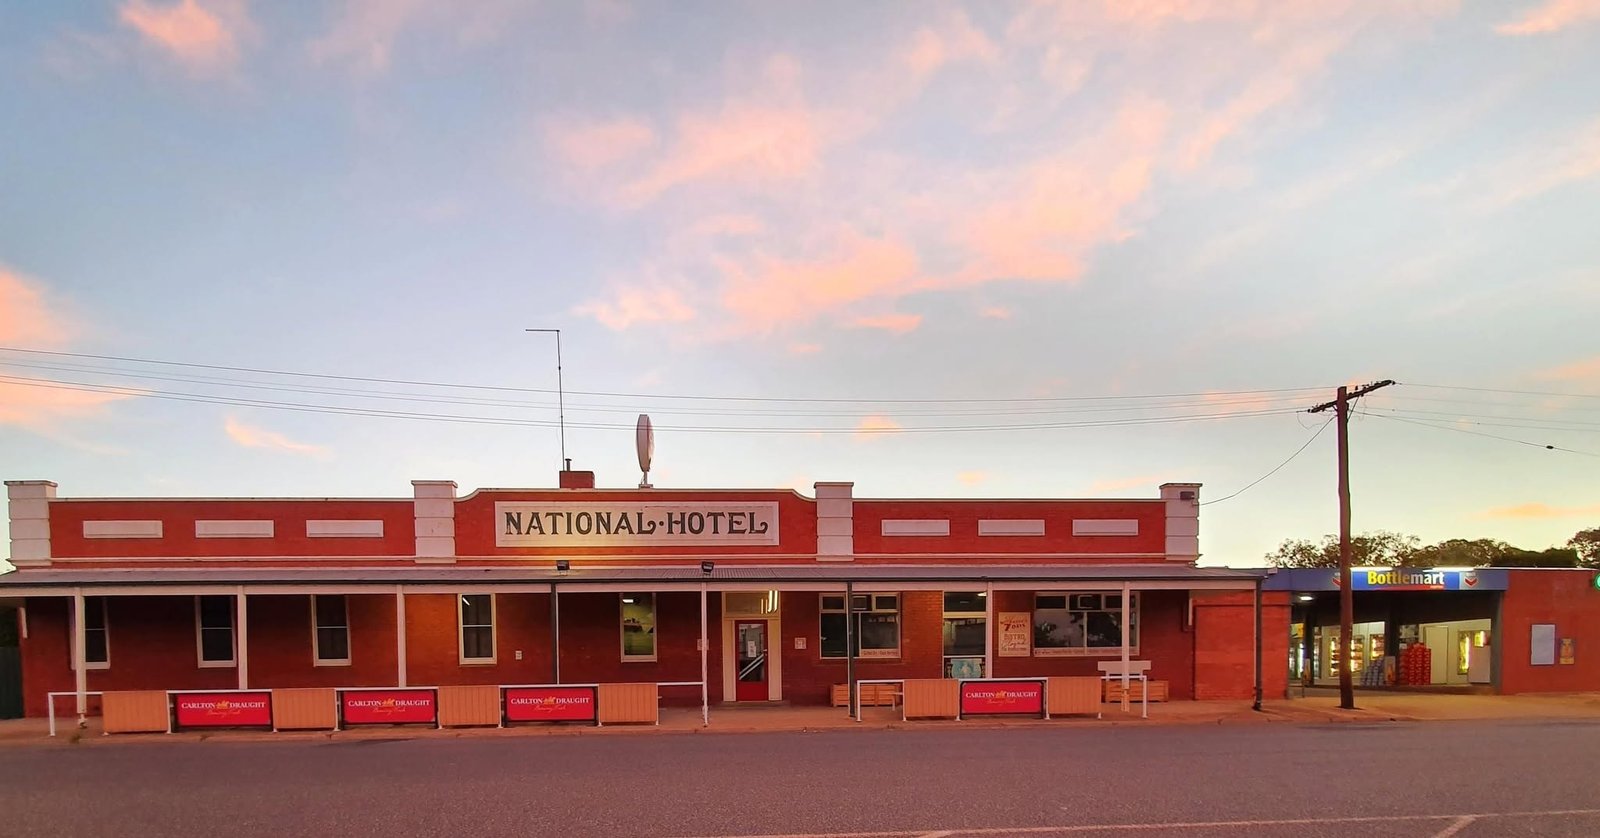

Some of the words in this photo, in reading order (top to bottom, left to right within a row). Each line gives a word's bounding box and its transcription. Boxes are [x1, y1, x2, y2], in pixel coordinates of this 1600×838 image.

[504, 511, 657, 535] NATIONAL
[666, 511, 769, 535] HOTEL
[1367, 570, 1445, 585] Bottlemart
